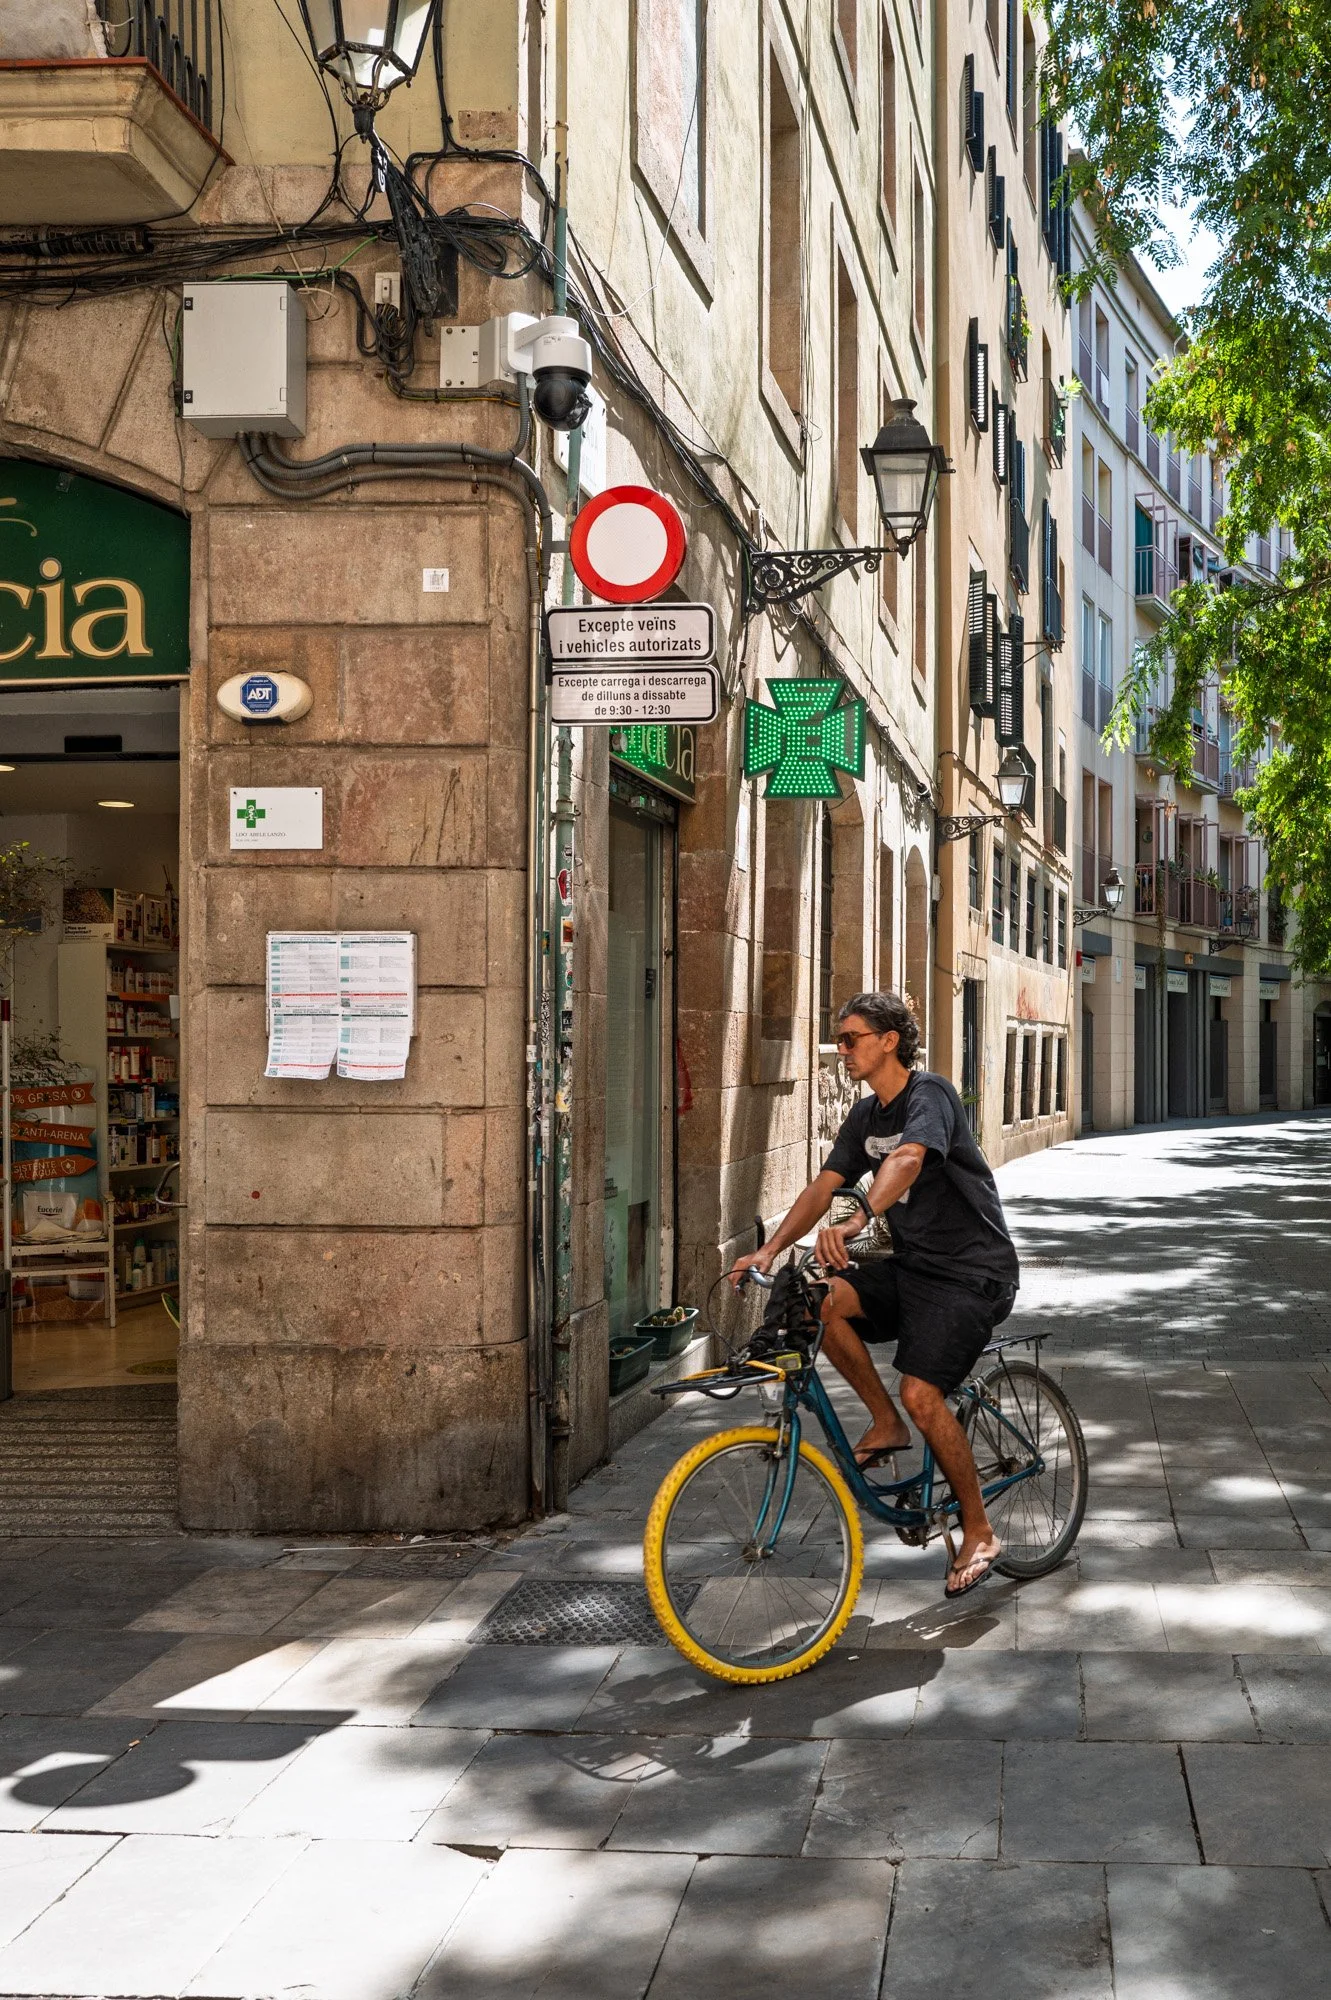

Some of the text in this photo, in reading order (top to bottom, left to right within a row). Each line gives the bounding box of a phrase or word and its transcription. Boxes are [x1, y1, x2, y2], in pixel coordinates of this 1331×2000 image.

[579, 616, 676, 635] Excepte veïns
[559, 637, 702, 653] i vehicles autorizats
[558, 675, 707, 689] Excepte carrega i descarrega
[247, 687, 272, 700] ADT
[581, 690, 686, 701] de dilluns a dissabte
[594, 706, 607, 716] de
[609, 705, 632, 716] 9:30
[641, 704, 671, 715] 12:30
[23, 1127, 85, 1141] ANTI-ARENA
[37, 1205, 64, 1213] Eucerin
